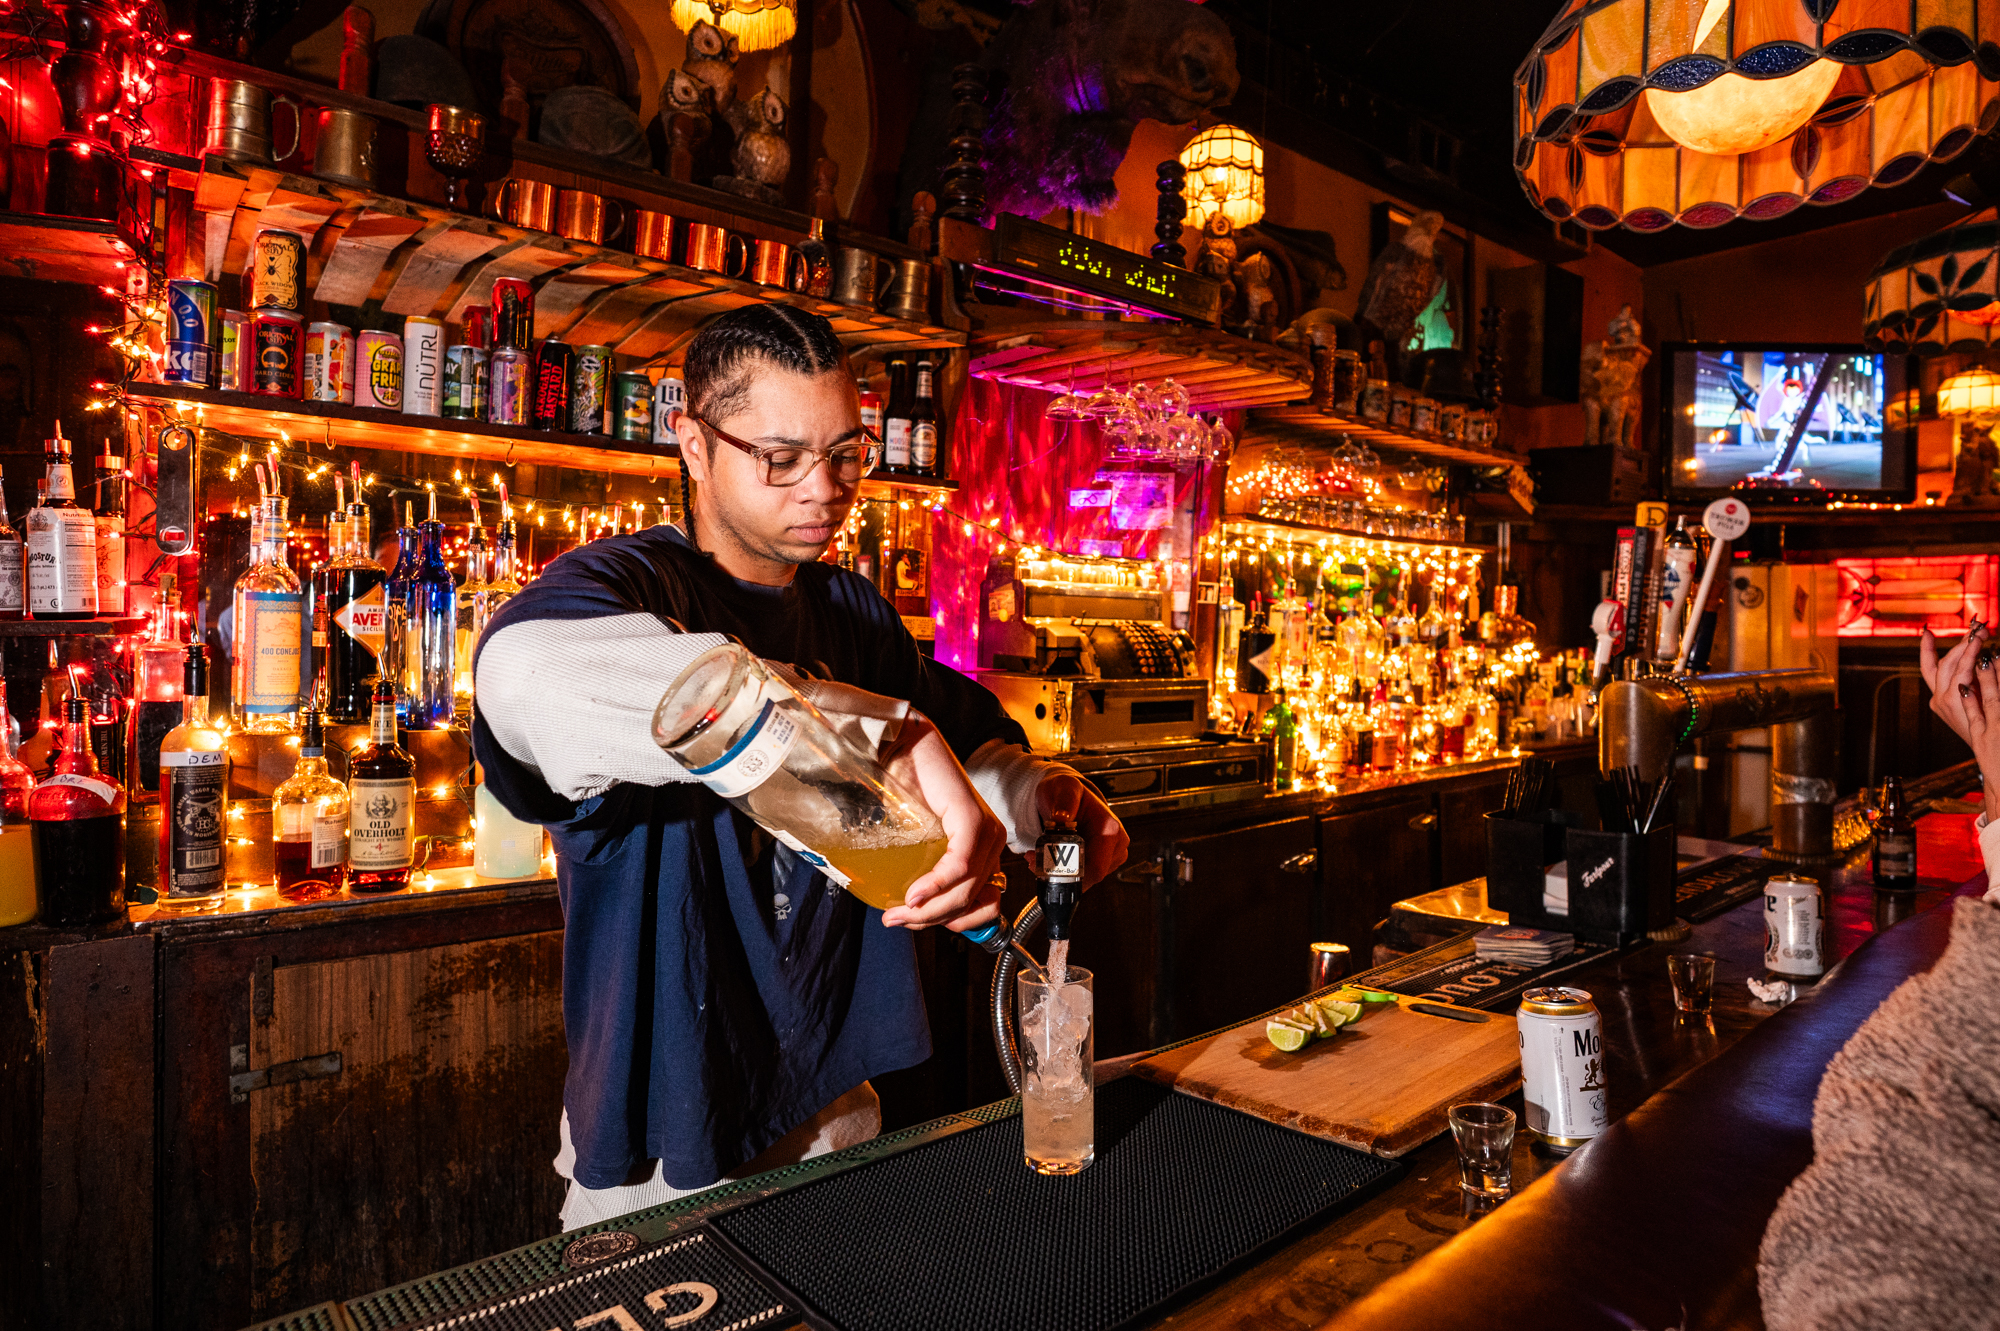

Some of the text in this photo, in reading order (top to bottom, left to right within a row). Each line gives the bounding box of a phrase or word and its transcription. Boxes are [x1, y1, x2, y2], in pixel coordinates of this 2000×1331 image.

[543, 365, 563, 420] BASTARD
[261, 647, 274, 655] 400
[369, 820, 391, 829] OLD
[354, 828, 407, 838] OVERHOLT
[375, 842, 382, 851] 4
[1046, 845, 1076, 867] W
